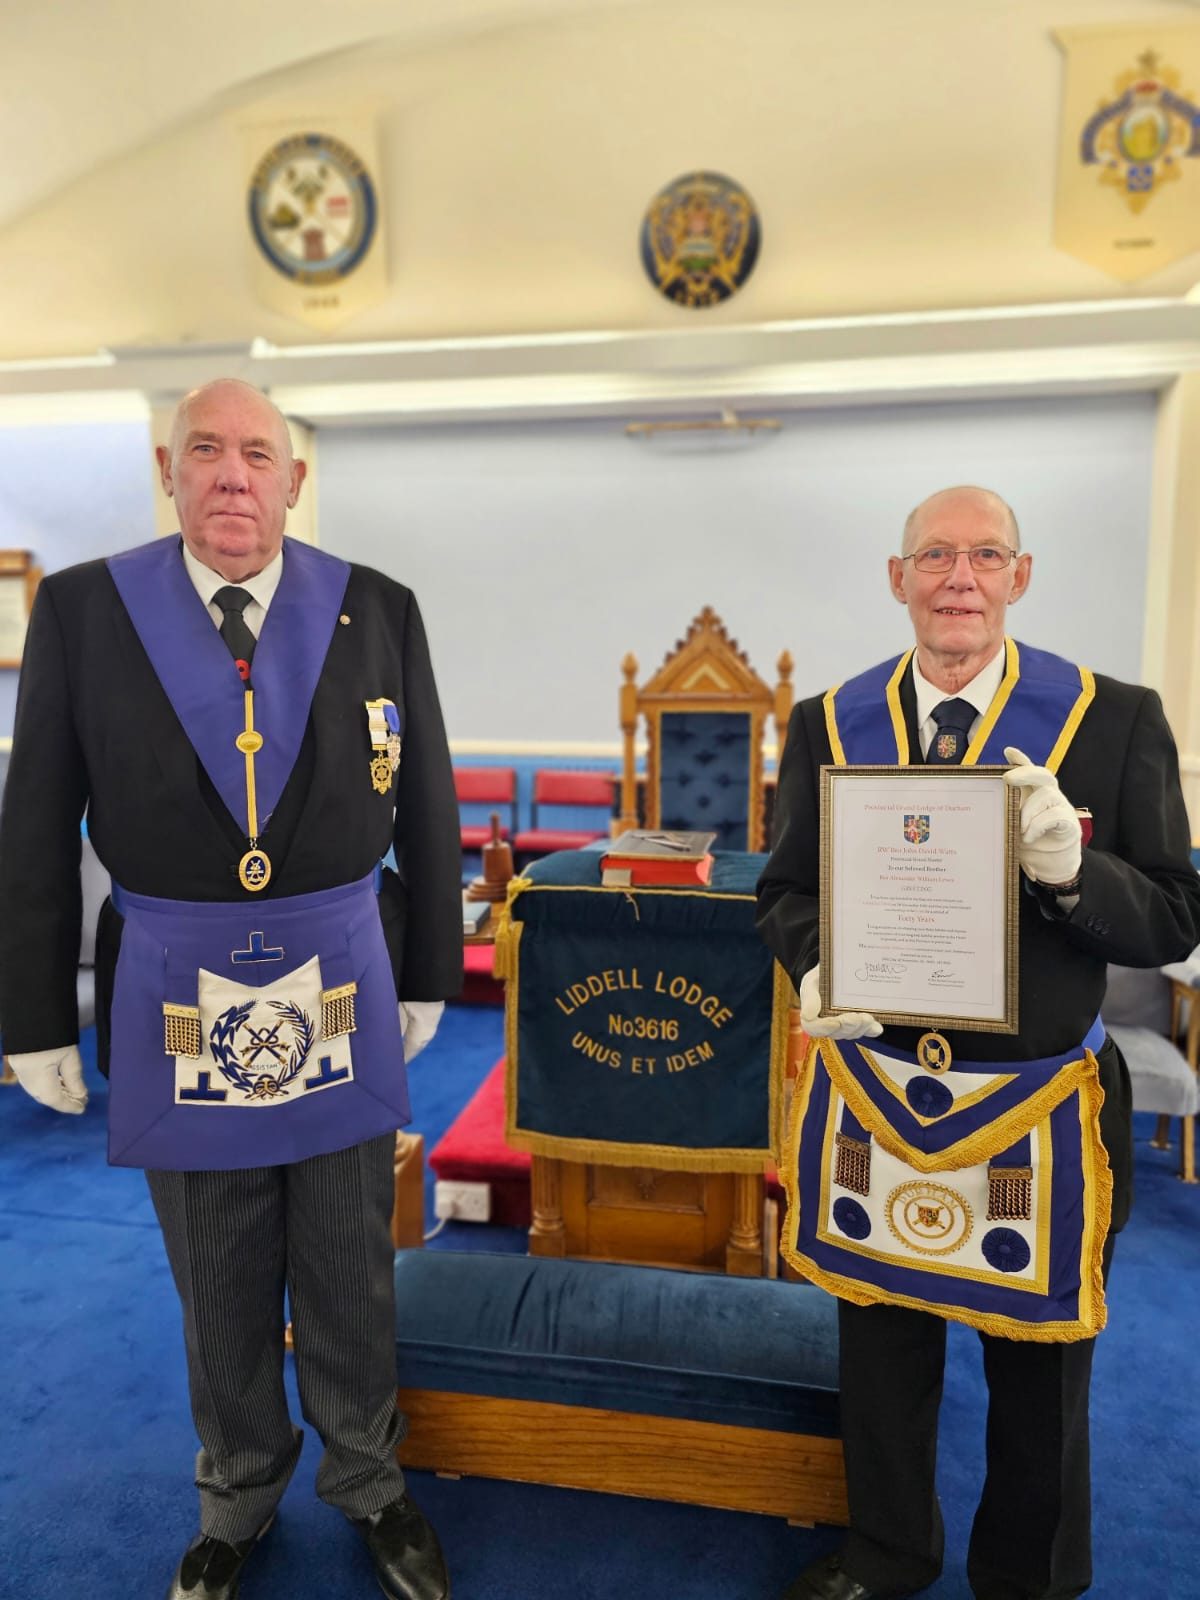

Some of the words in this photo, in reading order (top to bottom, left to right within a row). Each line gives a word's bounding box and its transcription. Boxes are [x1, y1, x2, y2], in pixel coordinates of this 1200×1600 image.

[555, 968, 643, 1015] LIDDELL
[655, 971, 733, 1028] LODGE
[608, 1013, 679, 1040] No3616
[572, 1031, 622, 1068] UNUS
[631, 1057, 656, 1074] ET
[666, 1041, 714, 1072] IDEM
